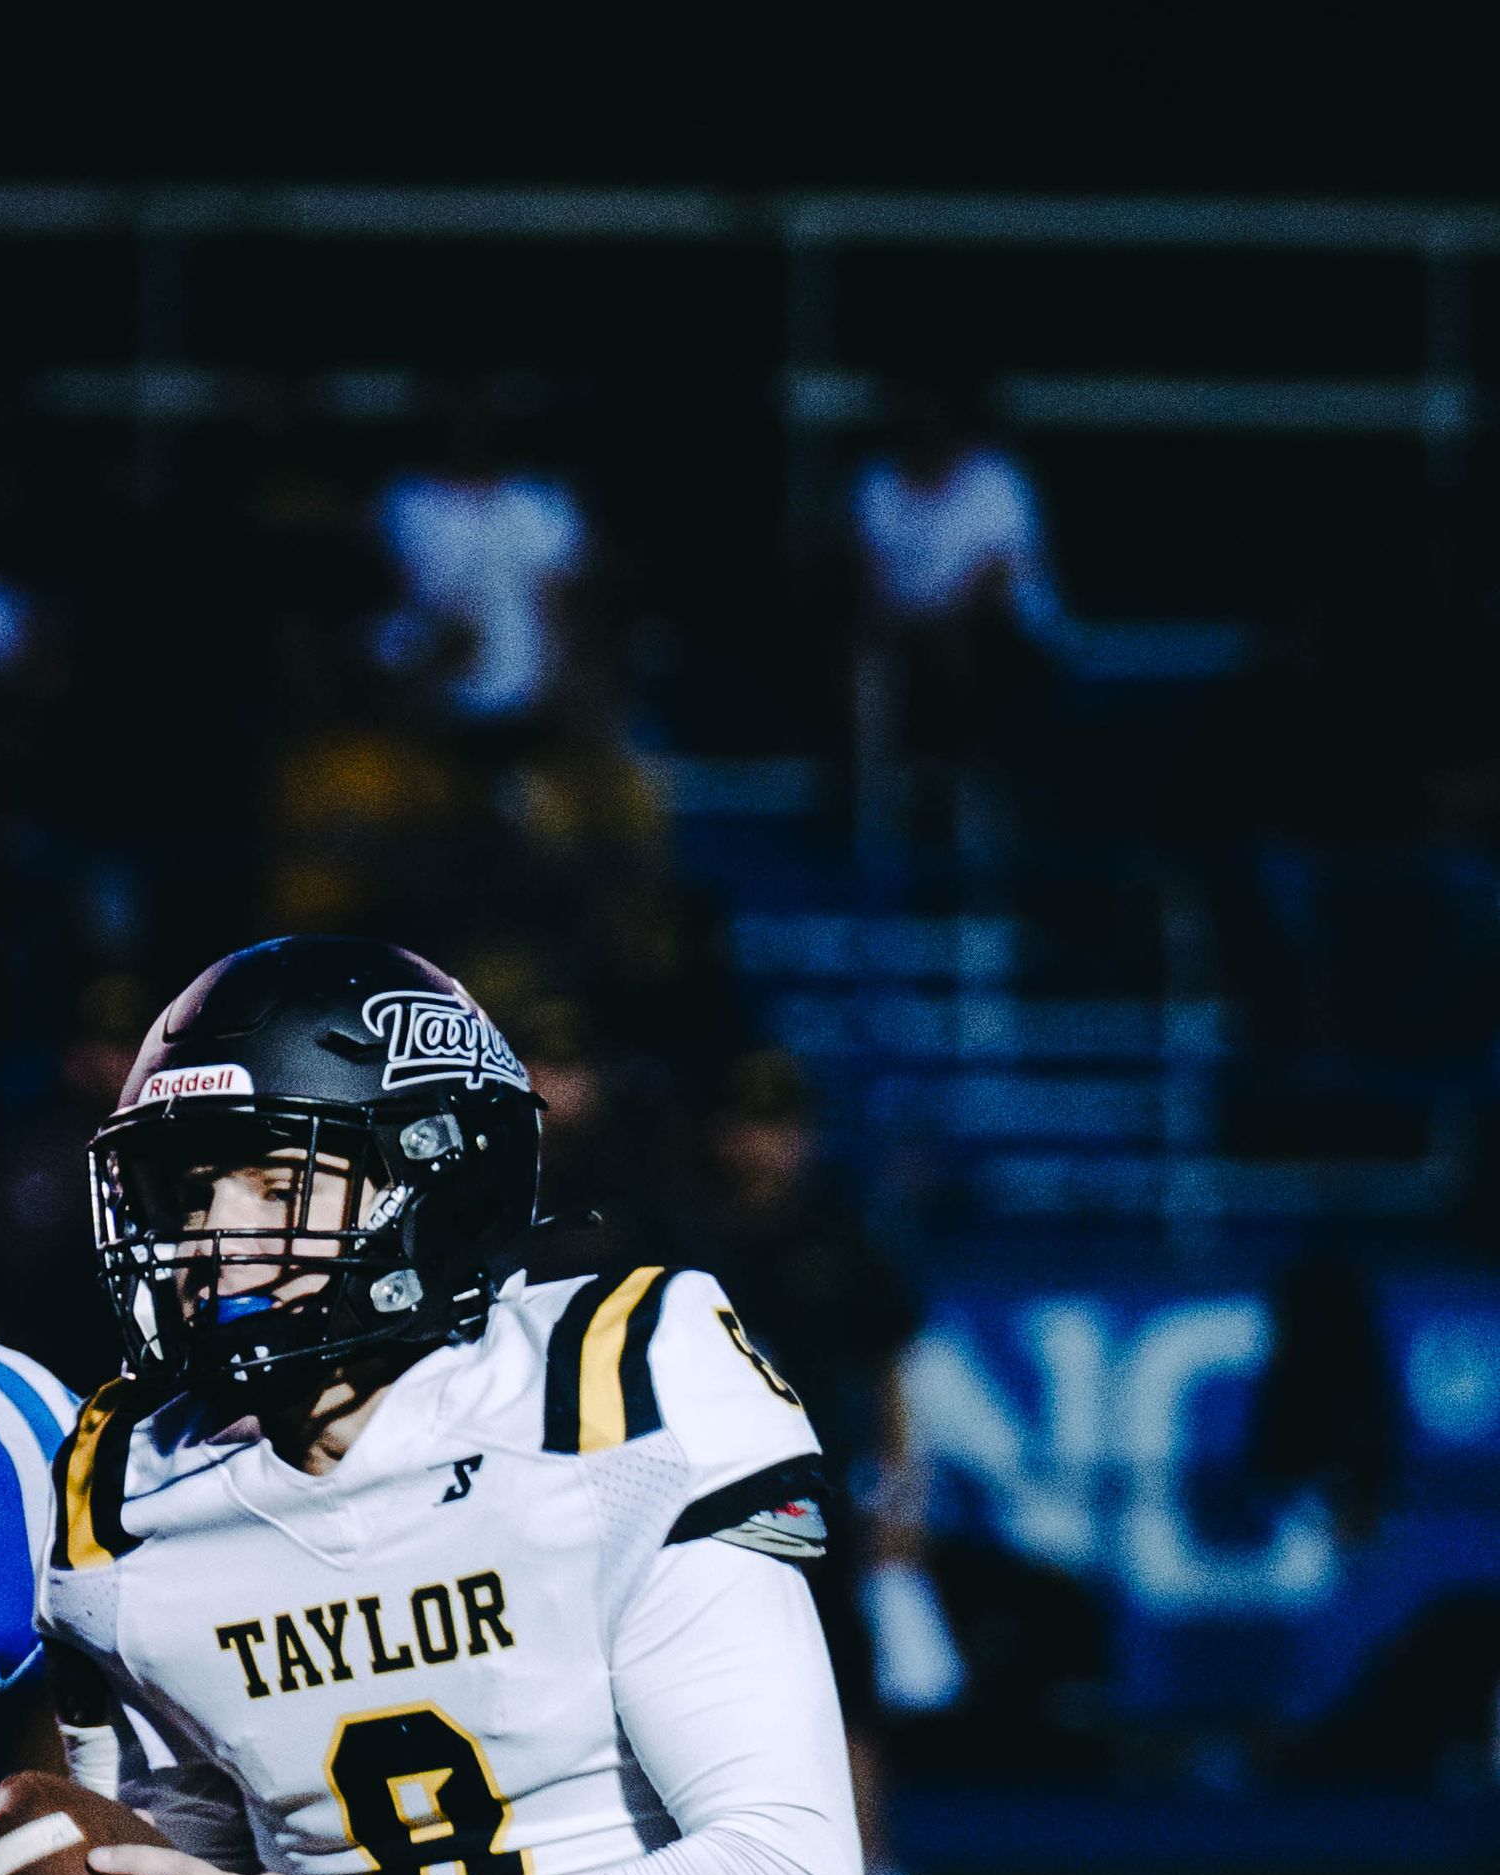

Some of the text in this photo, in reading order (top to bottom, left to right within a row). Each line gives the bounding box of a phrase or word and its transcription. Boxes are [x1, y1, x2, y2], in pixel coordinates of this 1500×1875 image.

[149, 1069, 234, 1098] Riddell
[362, 990, 531, 1092] Tayl
[215, 1569, 517, 1700] TAYLOR
